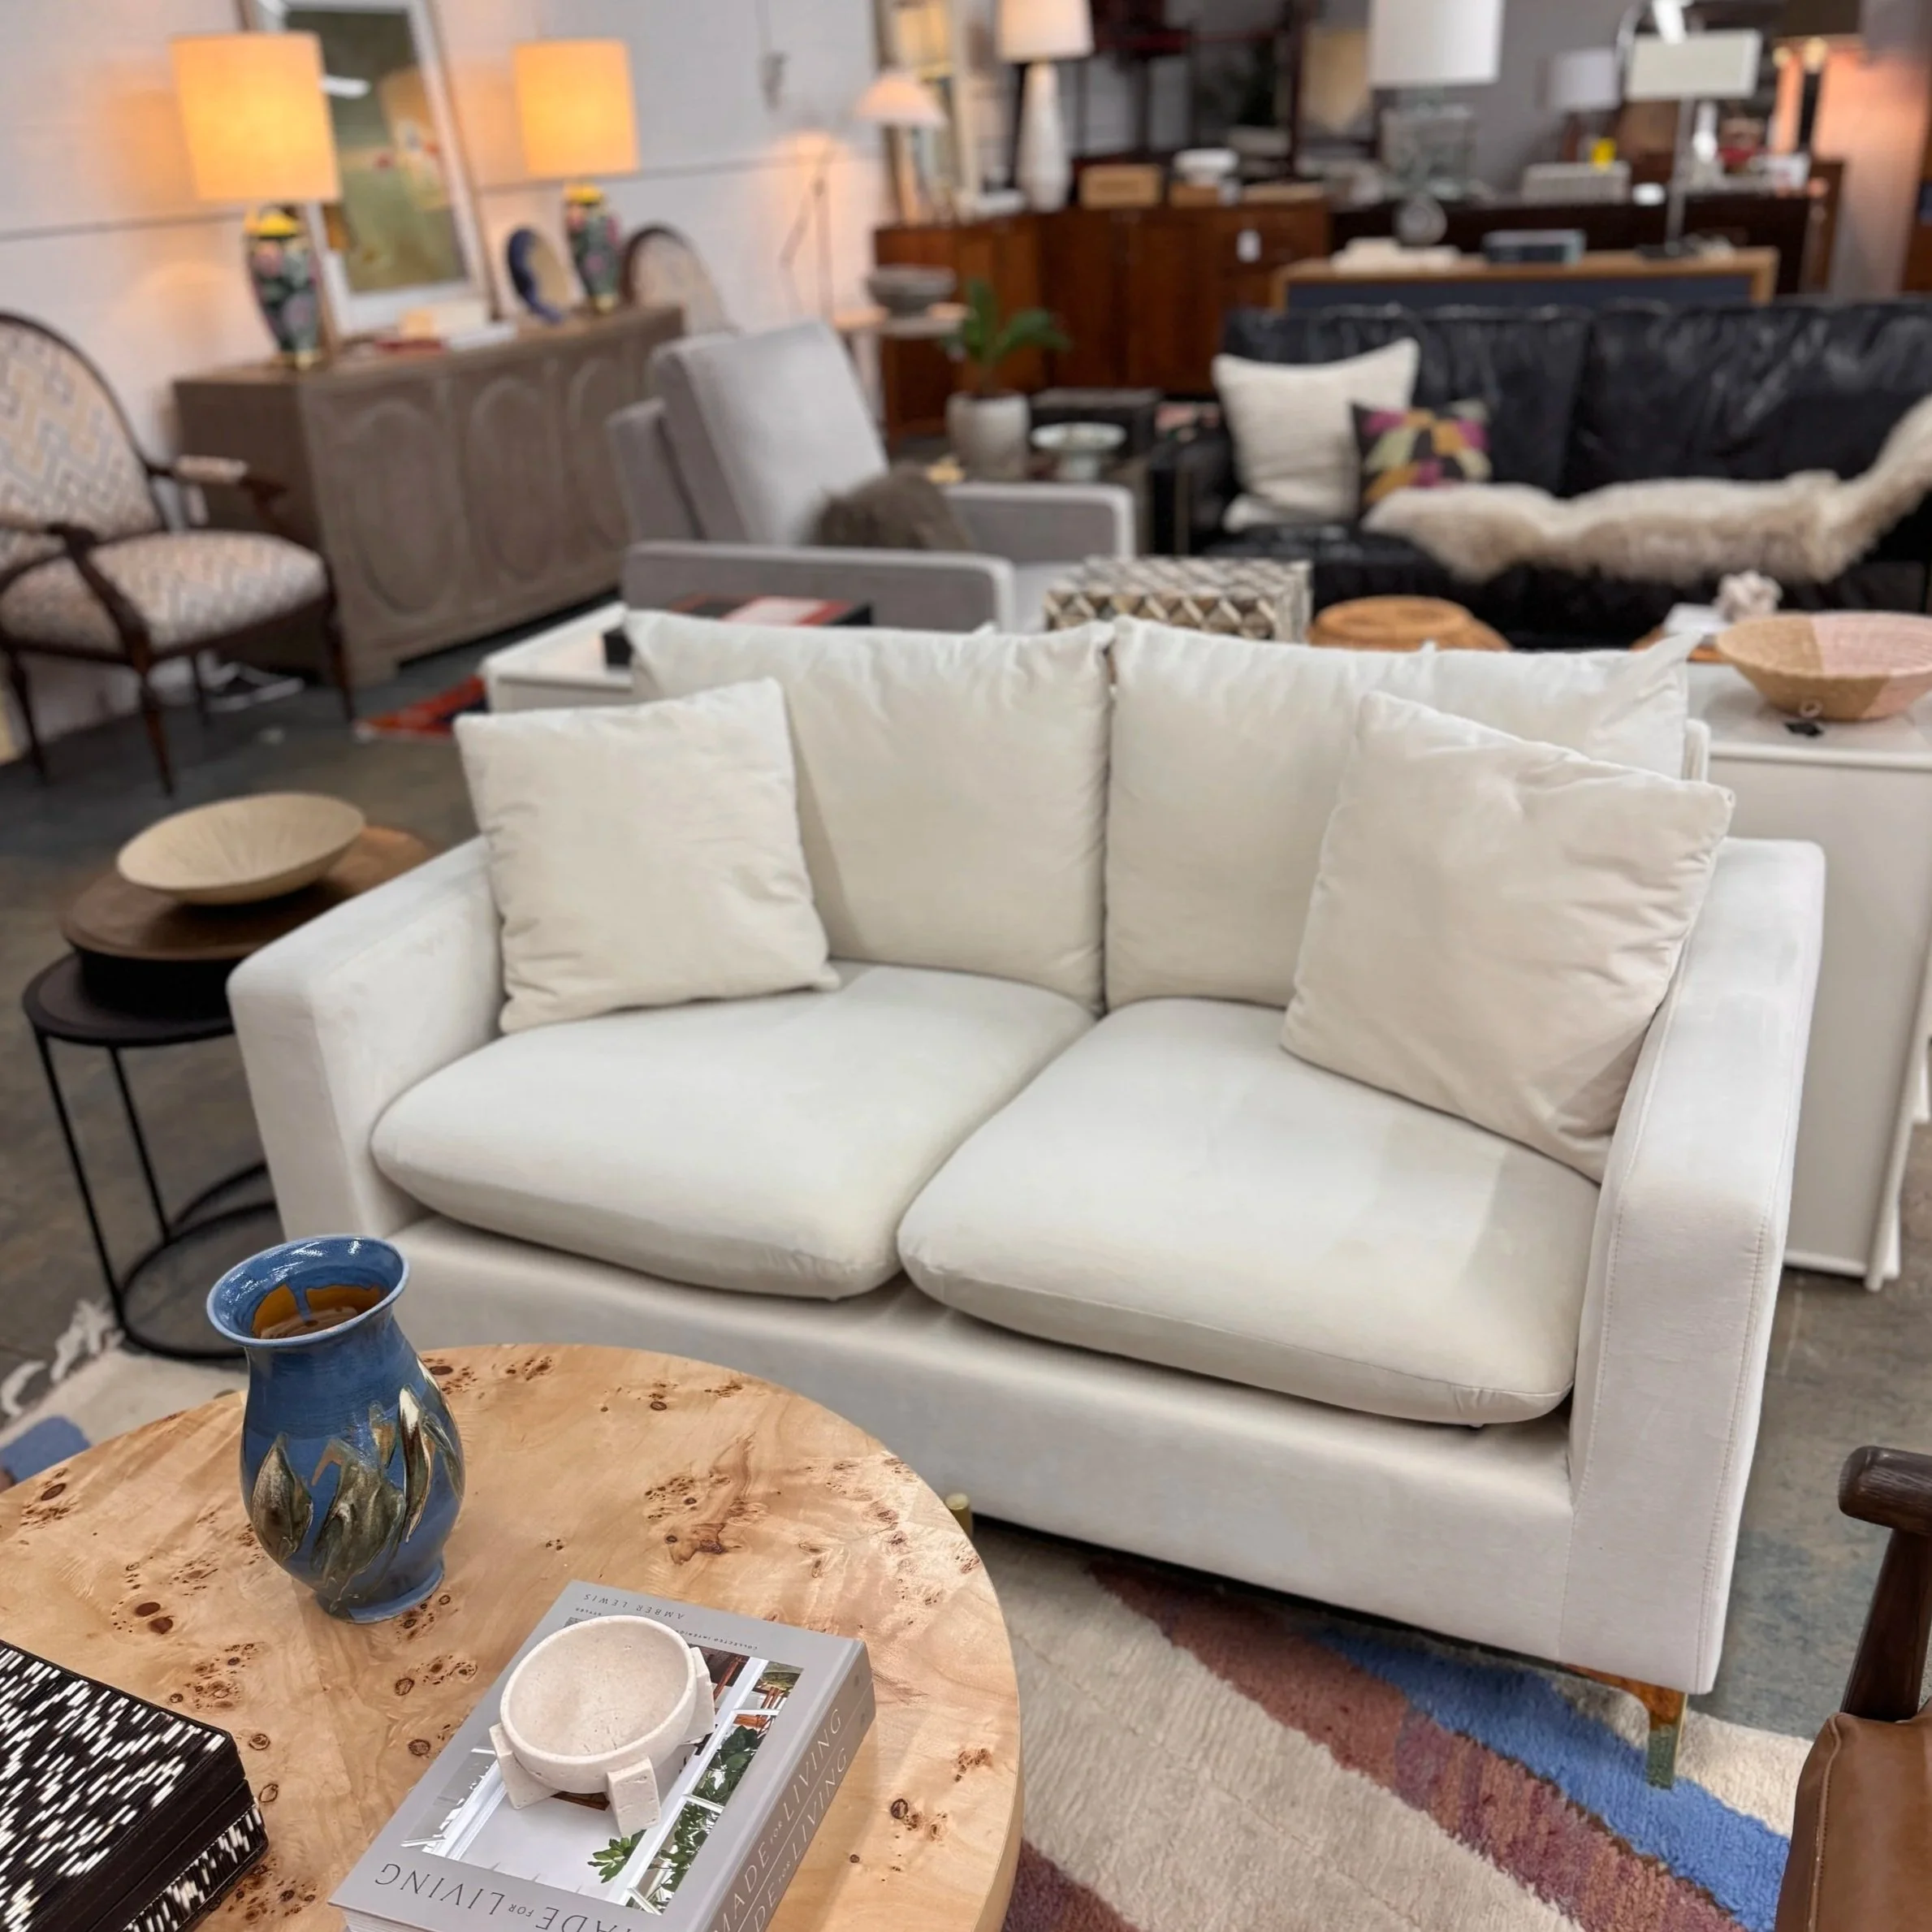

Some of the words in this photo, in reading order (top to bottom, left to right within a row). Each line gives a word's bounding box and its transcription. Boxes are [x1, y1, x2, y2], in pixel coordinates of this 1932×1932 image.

[584, 1593, 628, 1609] LEWIS
[636, 1604, 685, 1619] AMBER
[675, 1630, 711, 1641] INTERIO
[713, 1637, 758, 1650] COLLECTED
[770, 1821, 783, 1845] FOR
[782, 1709, 841, 1822] LIVING
[754, 1882, 777, 1932] DE
[792, 1748, 847, 1861] LIVING
[374, 1863, 506, 1916] LIVING
[508, 1903, 535, 1917] FOR
[535, 1906, 631, 1932] DE
